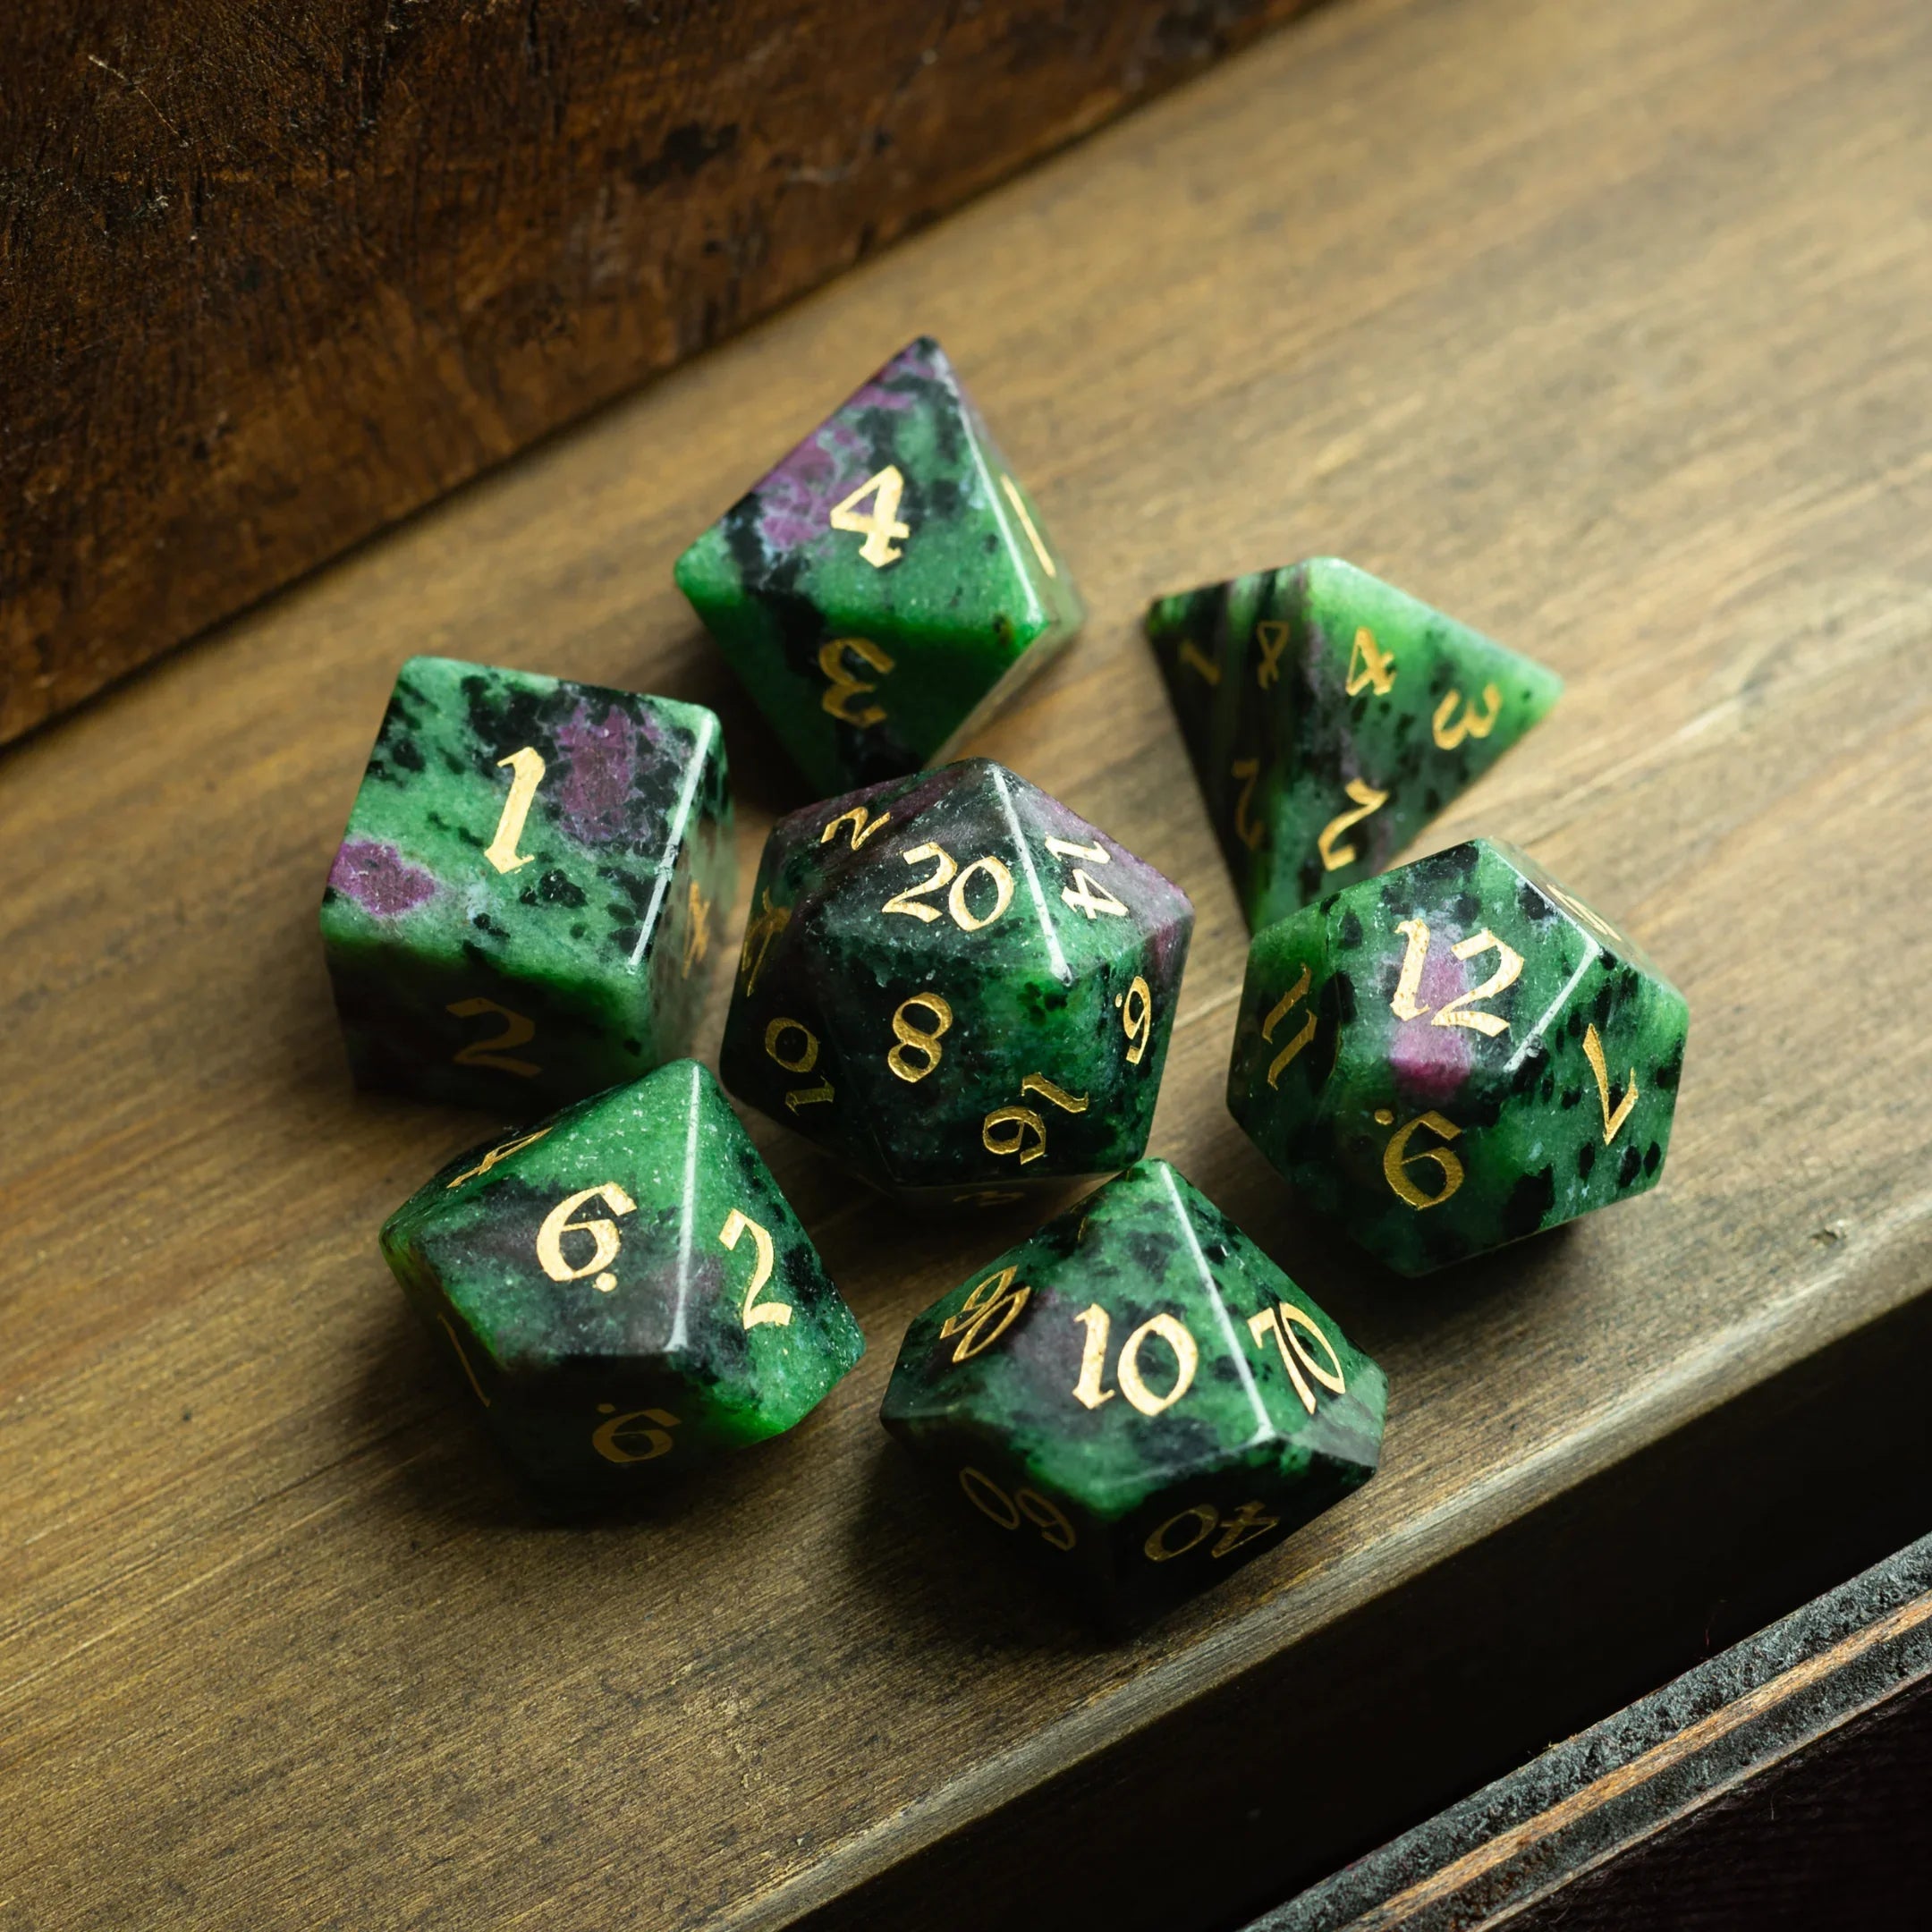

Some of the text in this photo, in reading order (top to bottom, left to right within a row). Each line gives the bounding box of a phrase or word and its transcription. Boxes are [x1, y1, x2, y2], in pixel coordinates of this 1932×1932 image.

[830, 465, 910, 567] 4
[818, 638, 894, 727] 3
[1346, 626, 1396, 696] 4
[1433, 683, 1502, 750] 3
[485, 747, 546, 874] 1
[821, 806, 891, 851] 2
[1318, 777, 1389, 871] 2
[881, 842, 1015, 932] 20
[1045, 831, 1130, 919] 14
[1390, 917, 1525, 1038] 12
[447, 996, 542, 1077] 2
[765, 1017, 835, 1115] 10
[887, 991, 953, 1083] 8
[1262, 962, 1318, 1091] 11
[983, 1072, 1089, 1165] 16
[1582, 1023, 1639, 1146] 7
[719, 1208, 792, 1330] 2
[1072, 1302, 1199, 1418] 10
[1247, 1301, 1347, 1416] 70
[1144, 1500, 1283, 1563] 40
